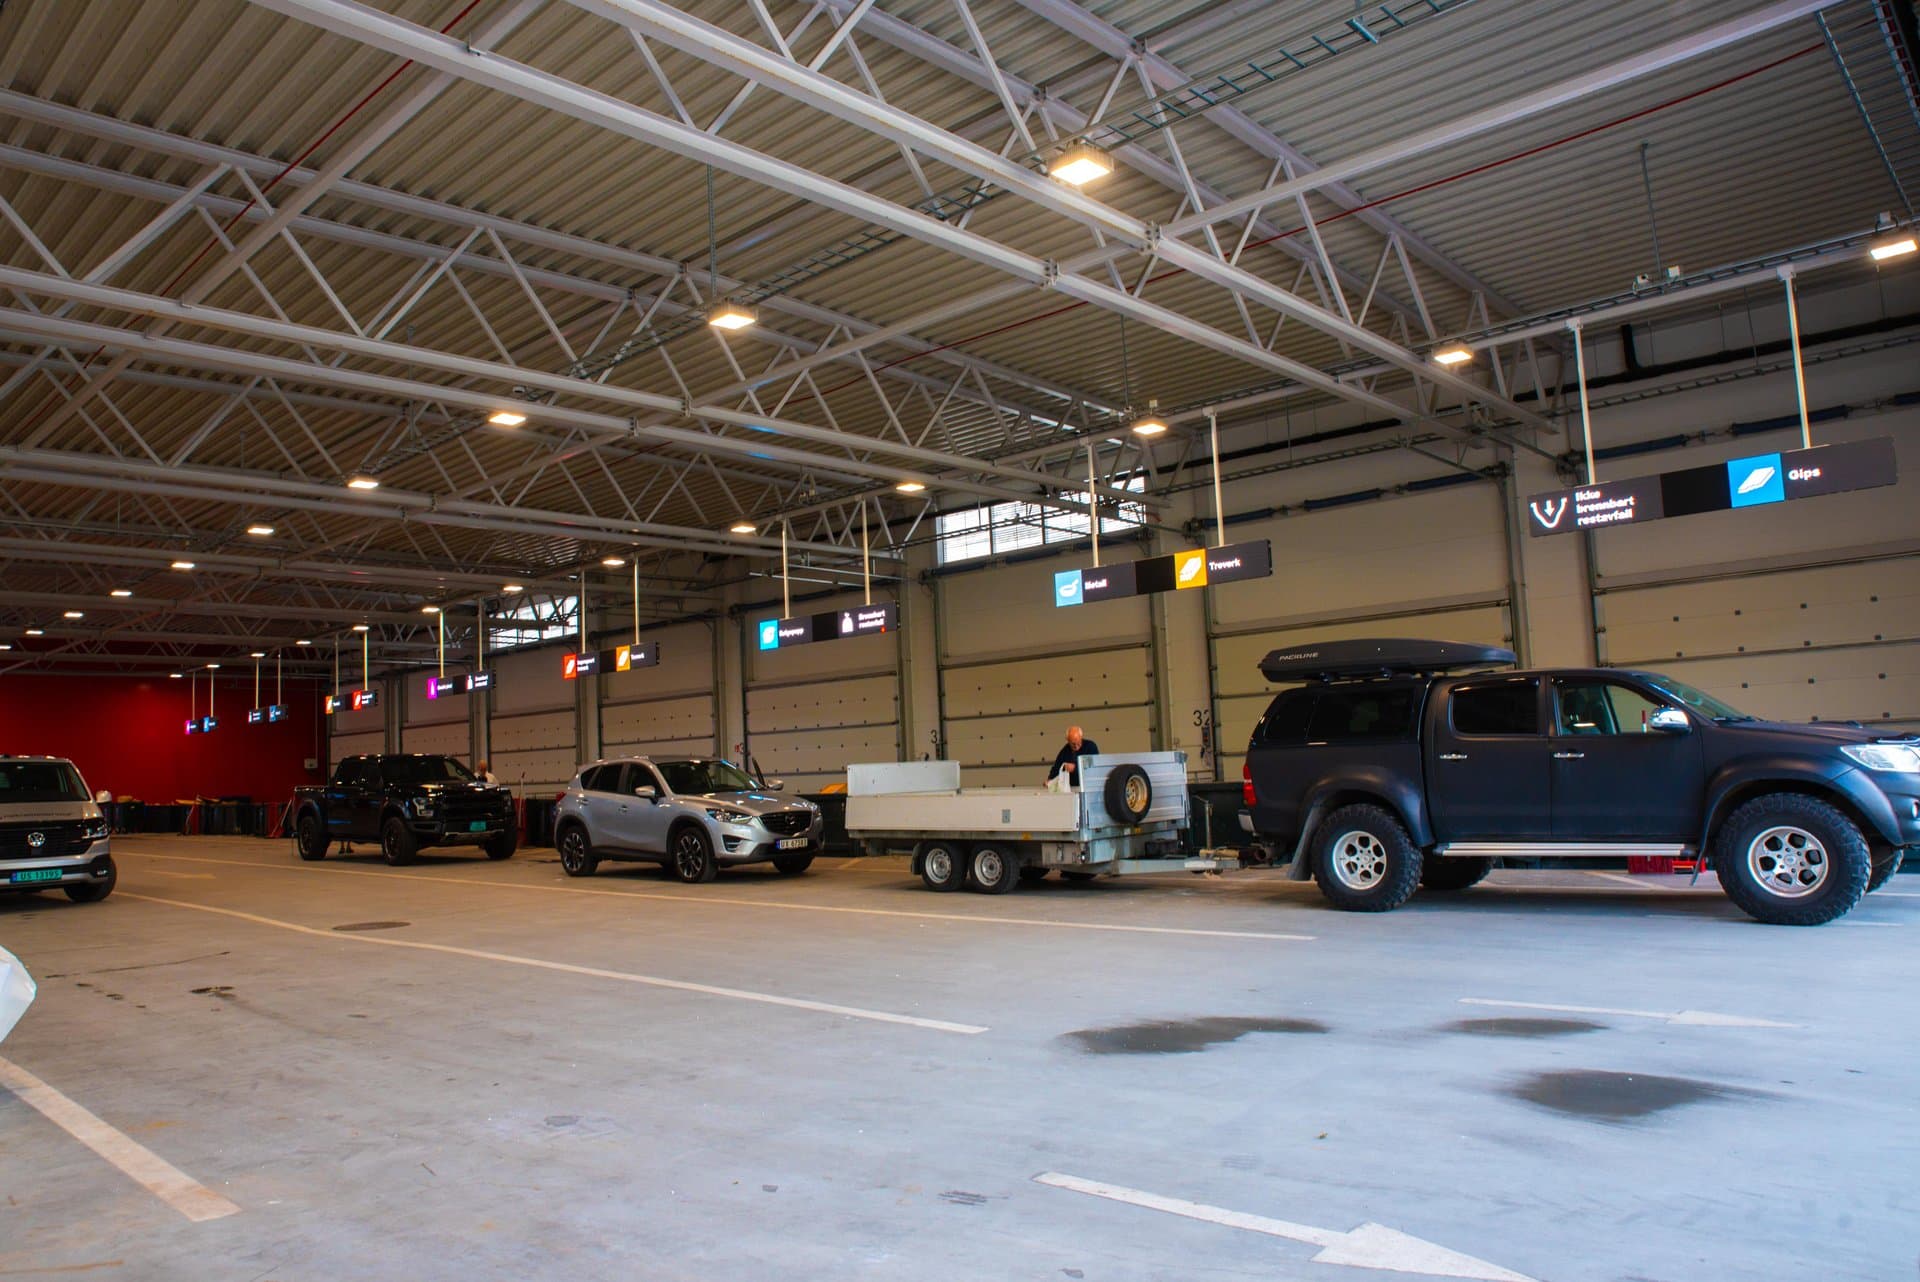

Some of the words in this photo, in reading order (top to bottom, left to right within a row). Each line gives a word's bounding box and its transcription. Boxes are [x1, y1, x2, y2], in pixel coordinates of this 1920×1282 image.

[1788, 467, 1822, 481] Gips
[1575, 490, 1602, 502] Ikke
[1576, 496, 1635, 514] brennbart
[1577, 508, 1633, 526] restavfall
[1279, 652, 1319, 662] PACKLINE
